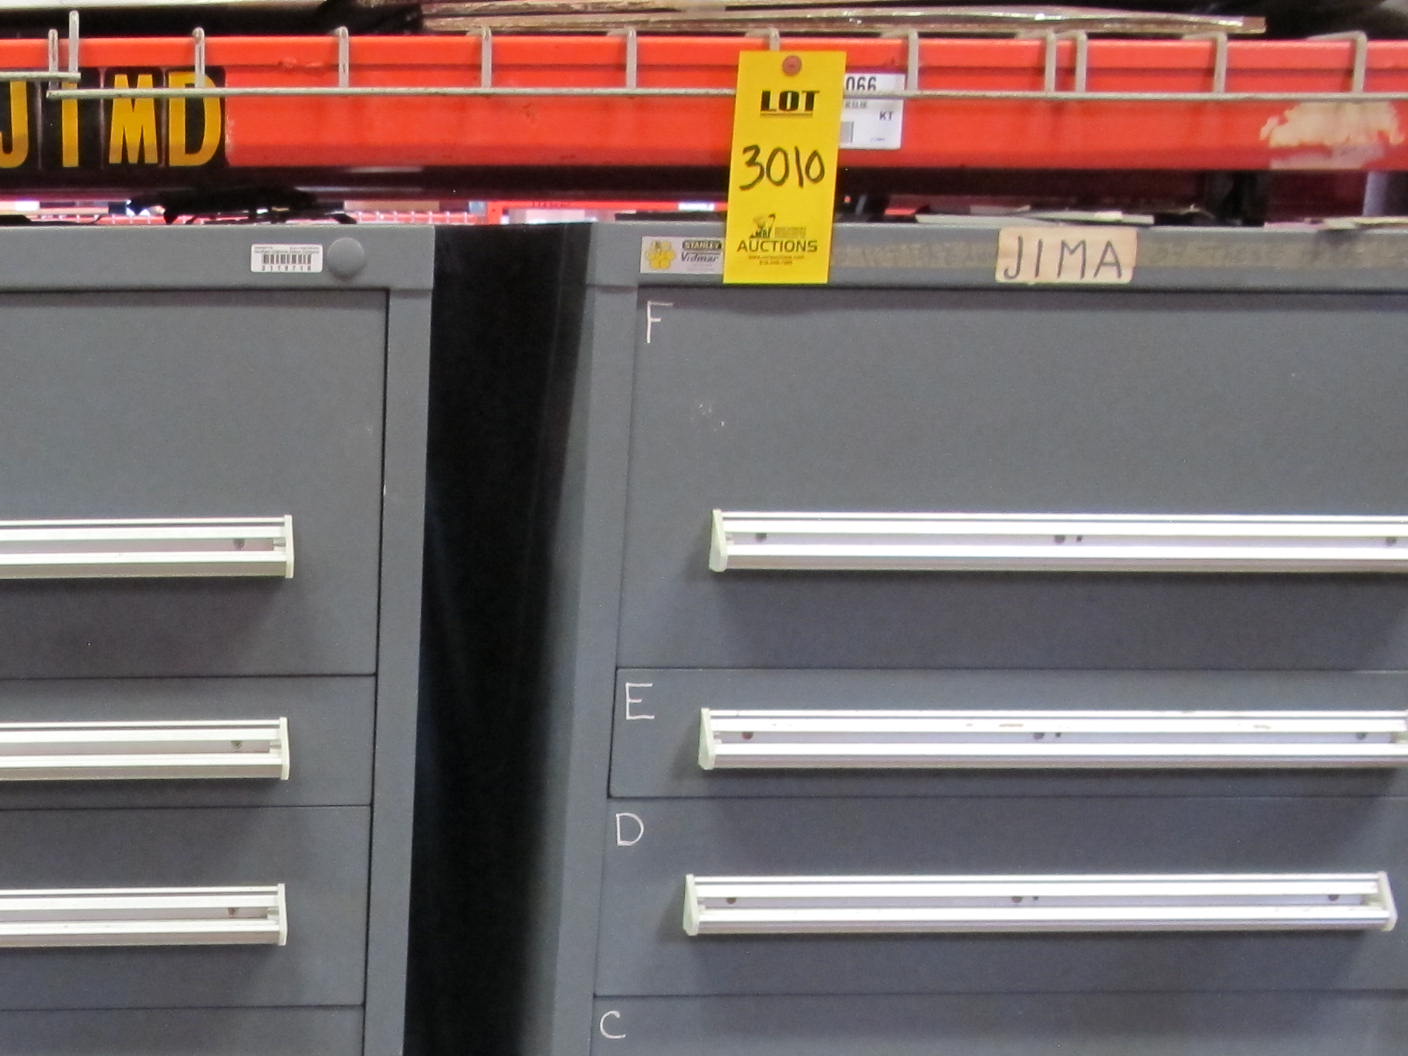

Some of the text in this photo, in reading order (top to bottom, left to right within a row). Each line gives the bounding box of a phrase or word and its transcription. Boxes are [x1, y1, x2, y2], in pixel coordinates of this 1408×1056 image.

[760, 90, 820, 112] LOT
[879, 111, 893, 120] KT
[740, 144, 825, 191] 3010
[680, 252, 719, 263] Vidmar
[684, 240, 721, 250] STANLEY
[736, 240, 818, 253] AUCTIONS
[1004, 234, 1122, 280] JIMA
[646, 300, 674, 344] F
[625, 682, 656, 720] E
[616, 812, 644, 847] D
[600, 1010, 626, 1039] C
